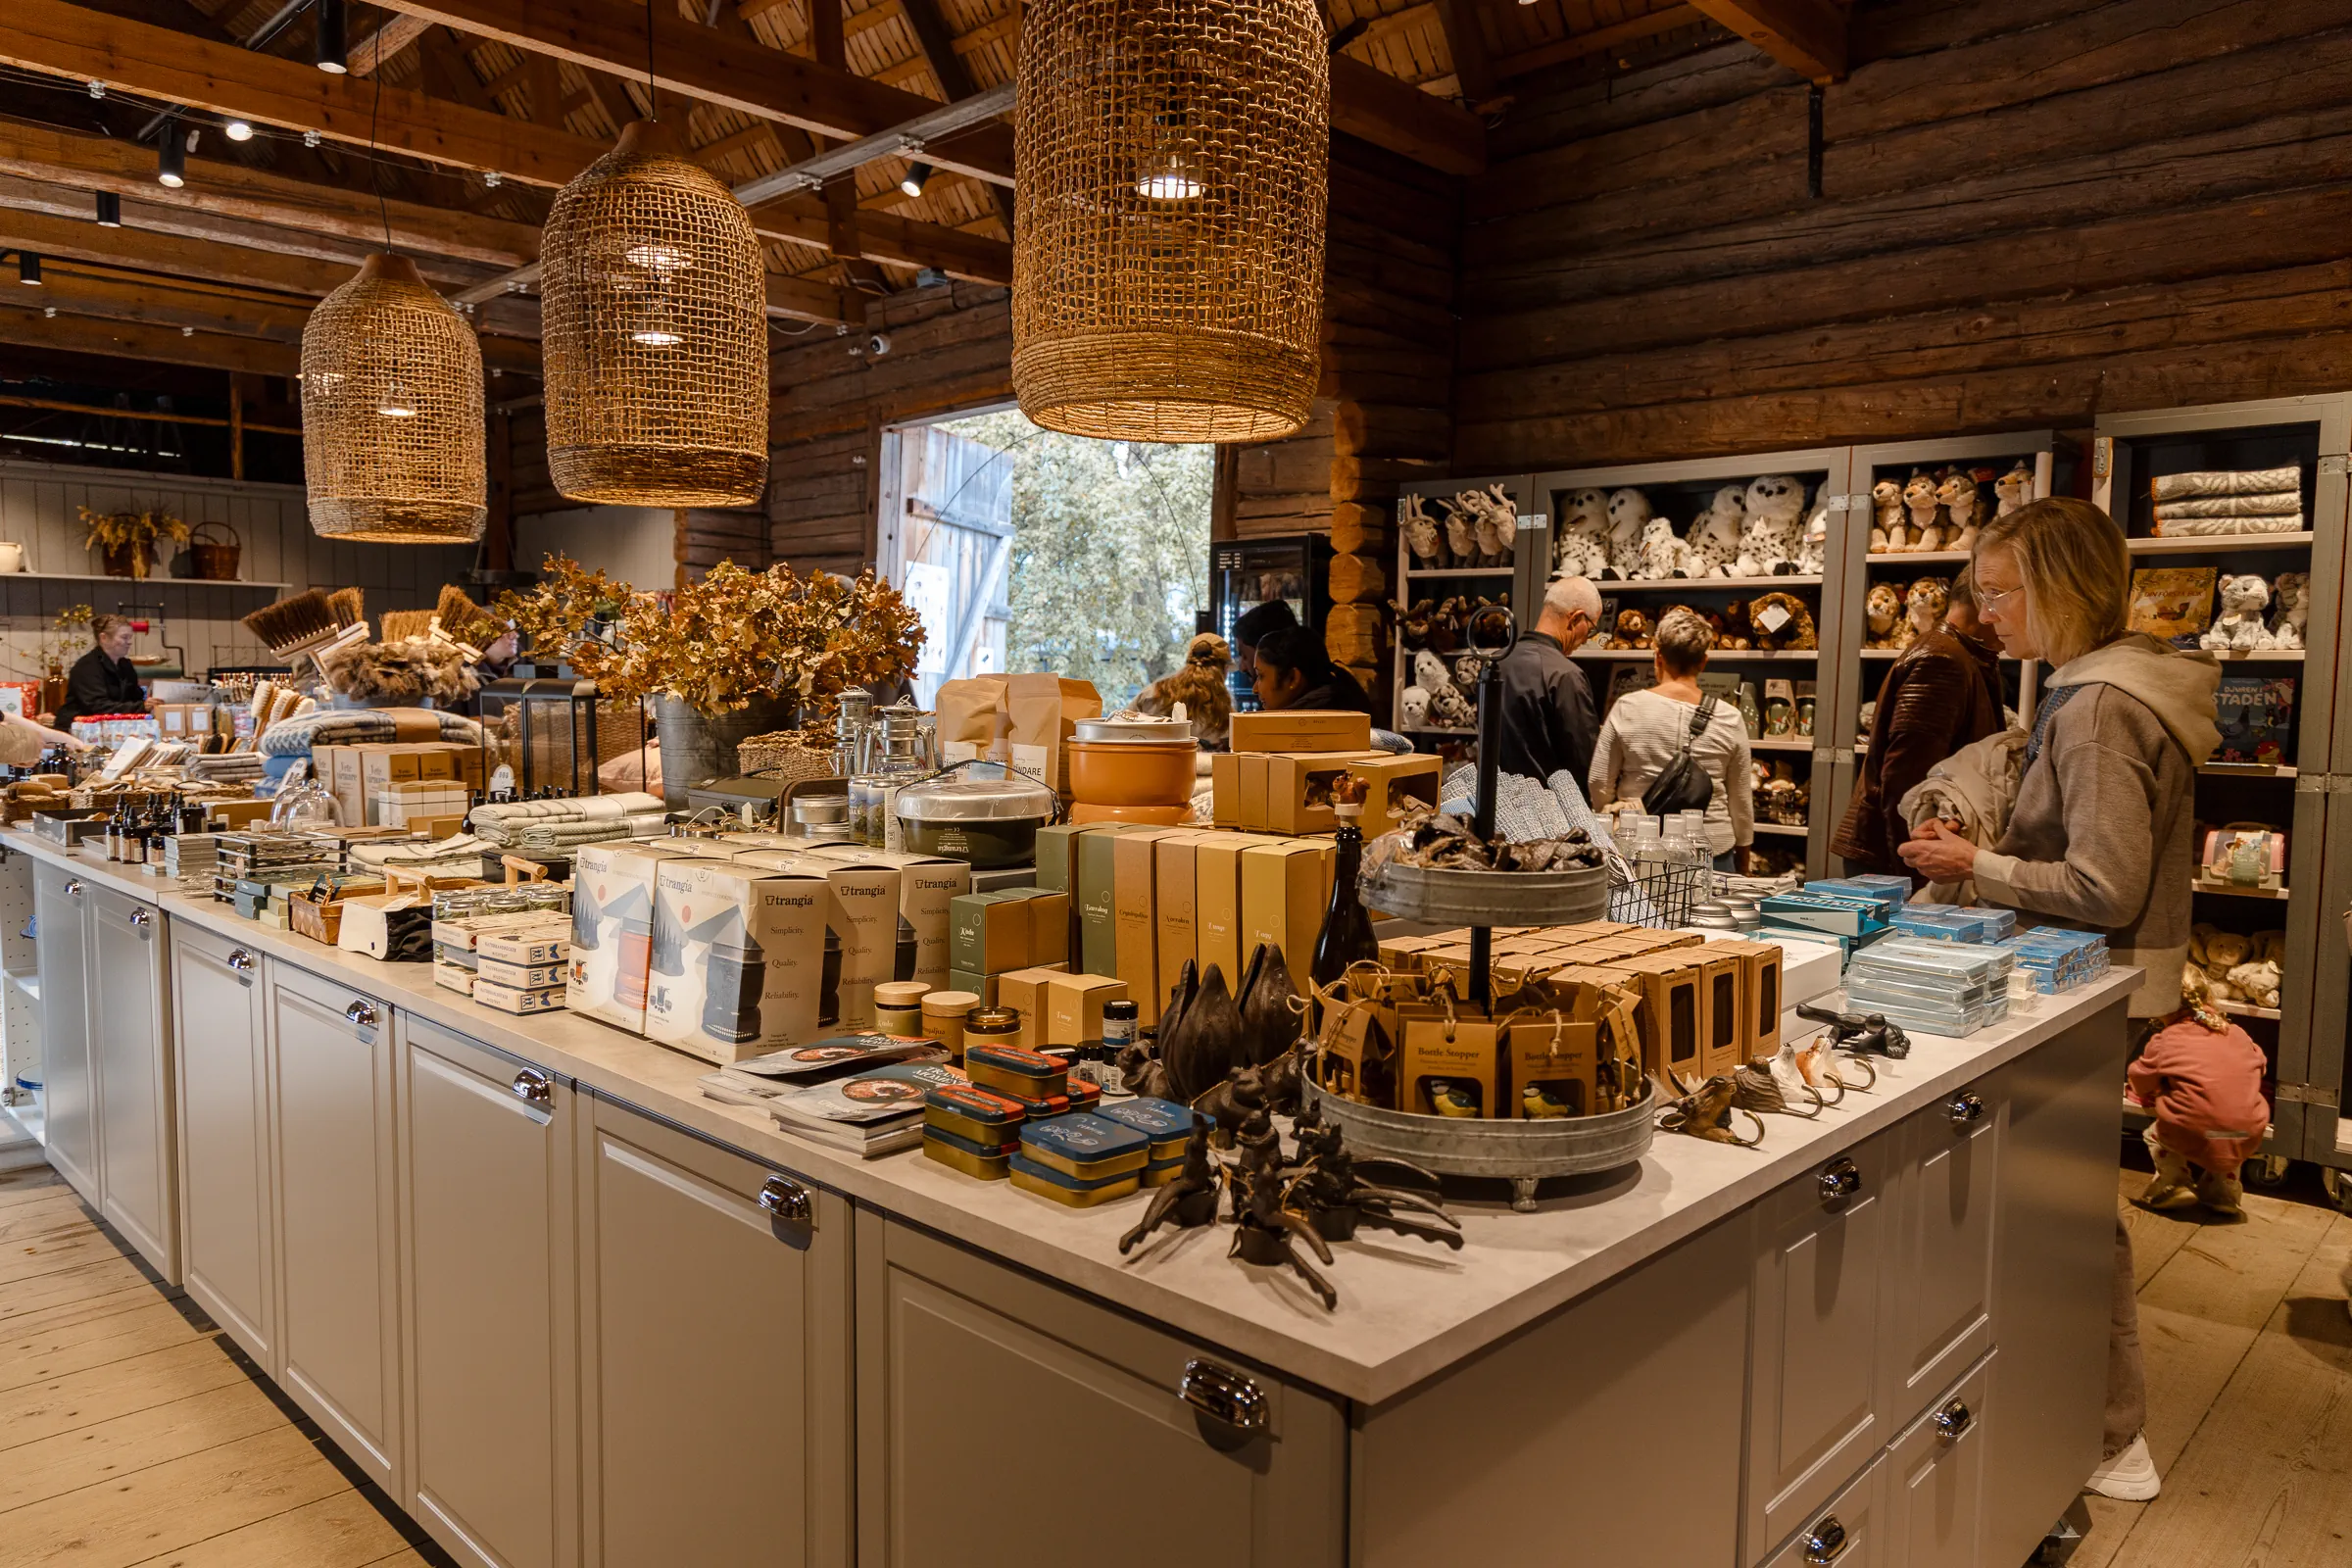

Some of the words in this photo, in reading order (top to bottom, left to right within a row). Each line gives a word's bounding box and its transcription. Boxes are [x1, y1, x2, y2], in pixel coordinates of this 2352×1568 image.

[2212, 692, 2278, 706] STADEN
[584, 857, 608, 874] trangia
[665, 875, 693, 894] trangia
[850, 884, 886, 898] trangia
[924, 878, 957, 891] trangia
[775, 894, 813, 908] trangia
[770, 926, 805, 936] Simplicity.
[848, 946, 872, 956] Quality.
[771, 958, 798, 968] Quality.
[764, 991, 800, 1001] Reliability.
[1418, 1047, 1444, 1056] Bottle
[1446, 1050, 1480, 1060] Stopper
[1524, 1052, 1550, 1061] Bottle
